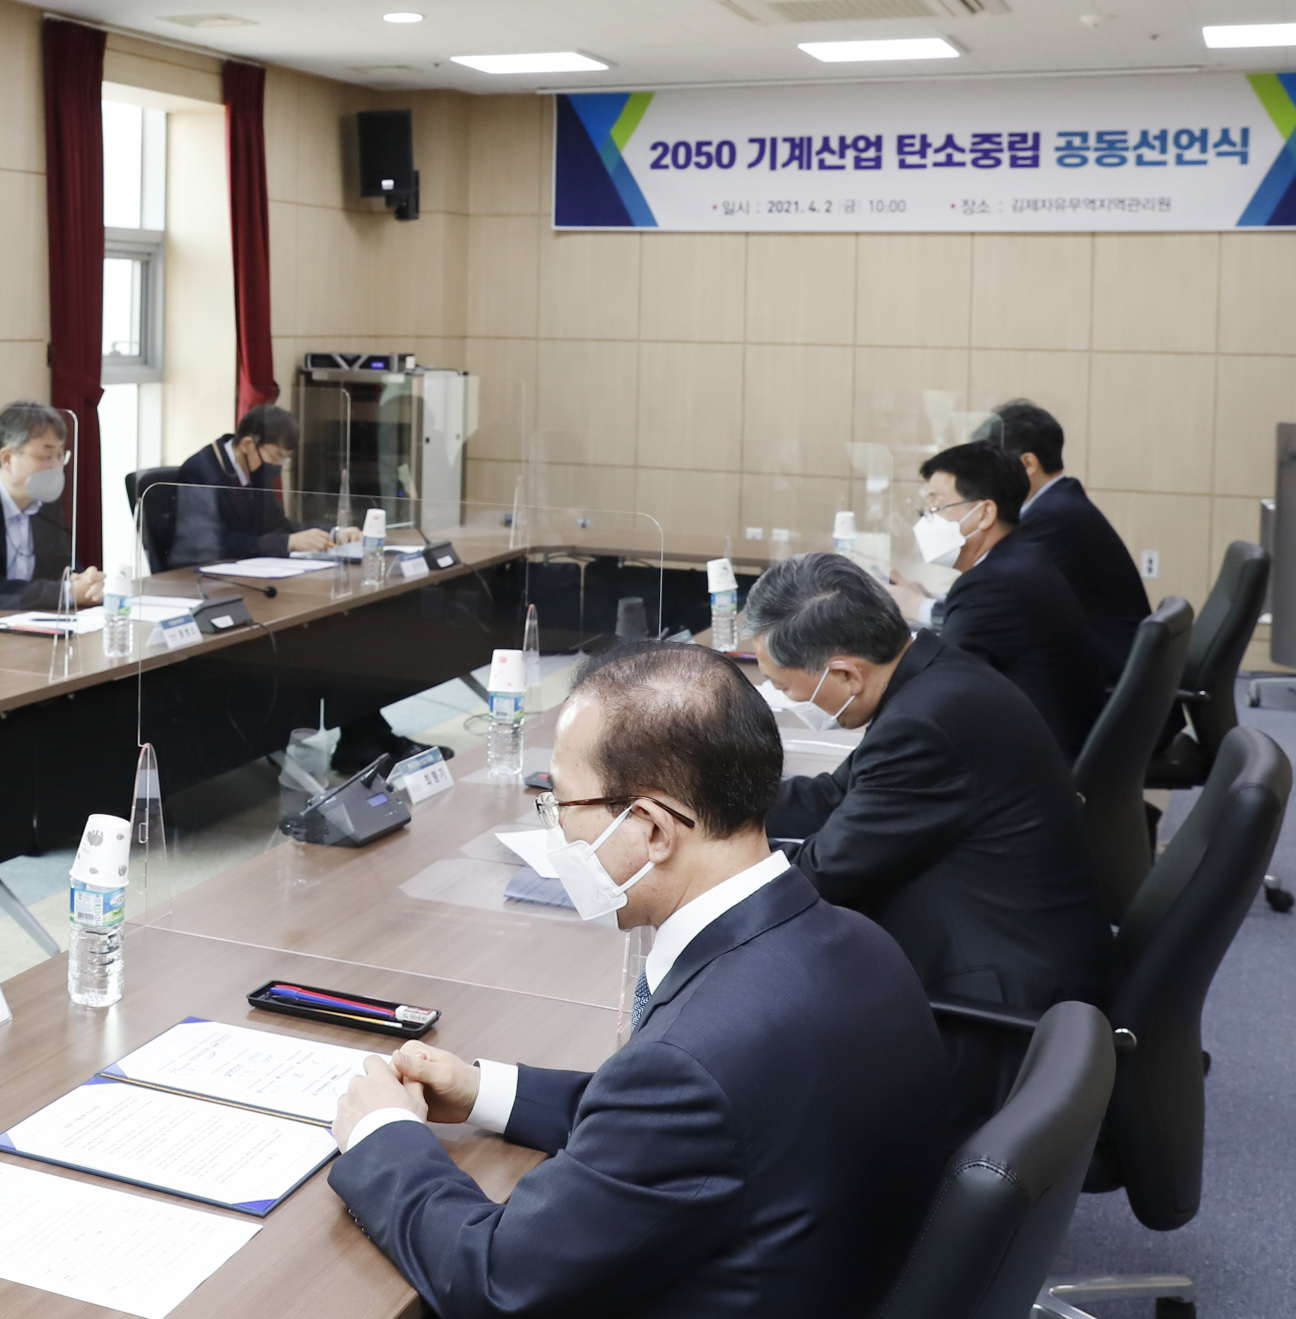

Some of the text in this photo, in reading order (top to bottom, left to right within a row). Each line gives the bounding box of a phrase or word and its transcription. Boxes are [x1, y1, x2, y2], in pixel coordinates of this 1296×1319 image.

[649, 127, 1249, 171] 2050 기계산업 탄소중립 공동선언식
[722, 200, 750, 215] 일시
[869, 199, 907, 213] 10:00
[961, 199, 990, 215] 장소
